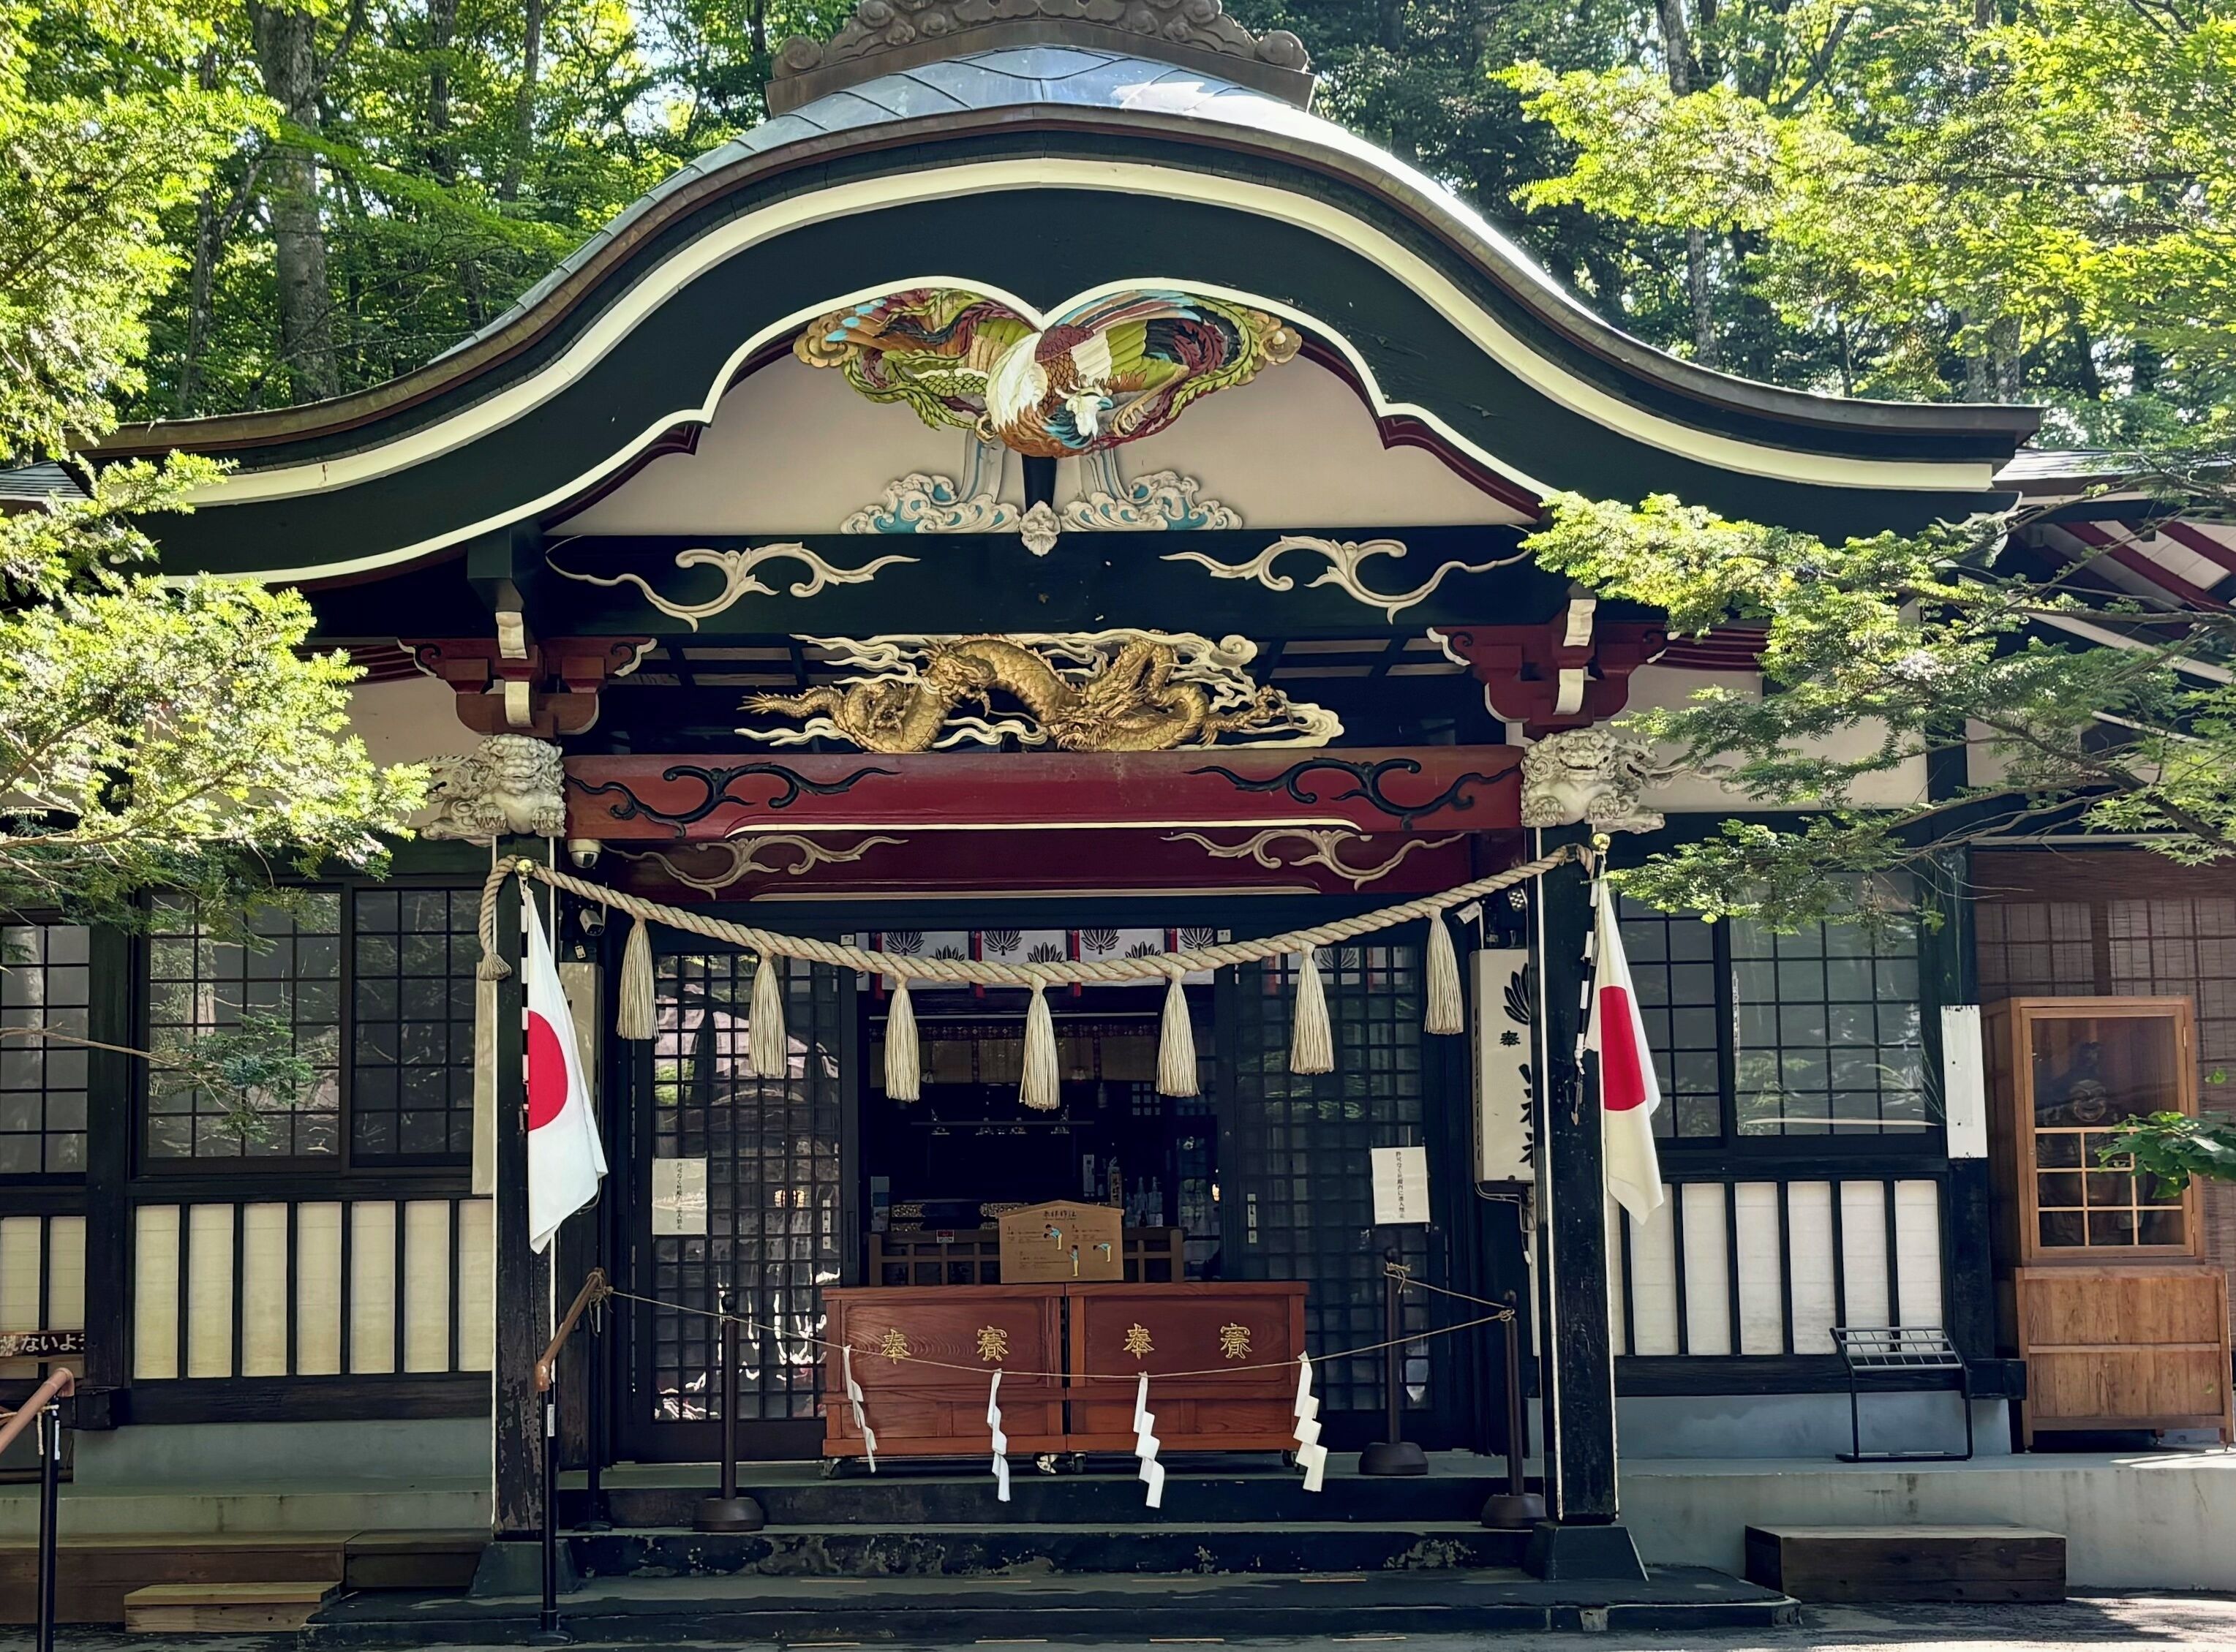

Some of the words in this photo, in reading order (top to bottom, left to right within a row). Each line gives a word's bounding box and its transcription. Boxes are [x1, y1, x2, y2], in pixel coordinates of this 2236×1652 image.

[1499, 1030, 1521, 1048] 奉
[881, 1328, 911, 1365] 奉
[1123, 1322, 1155, 1360] 奉
